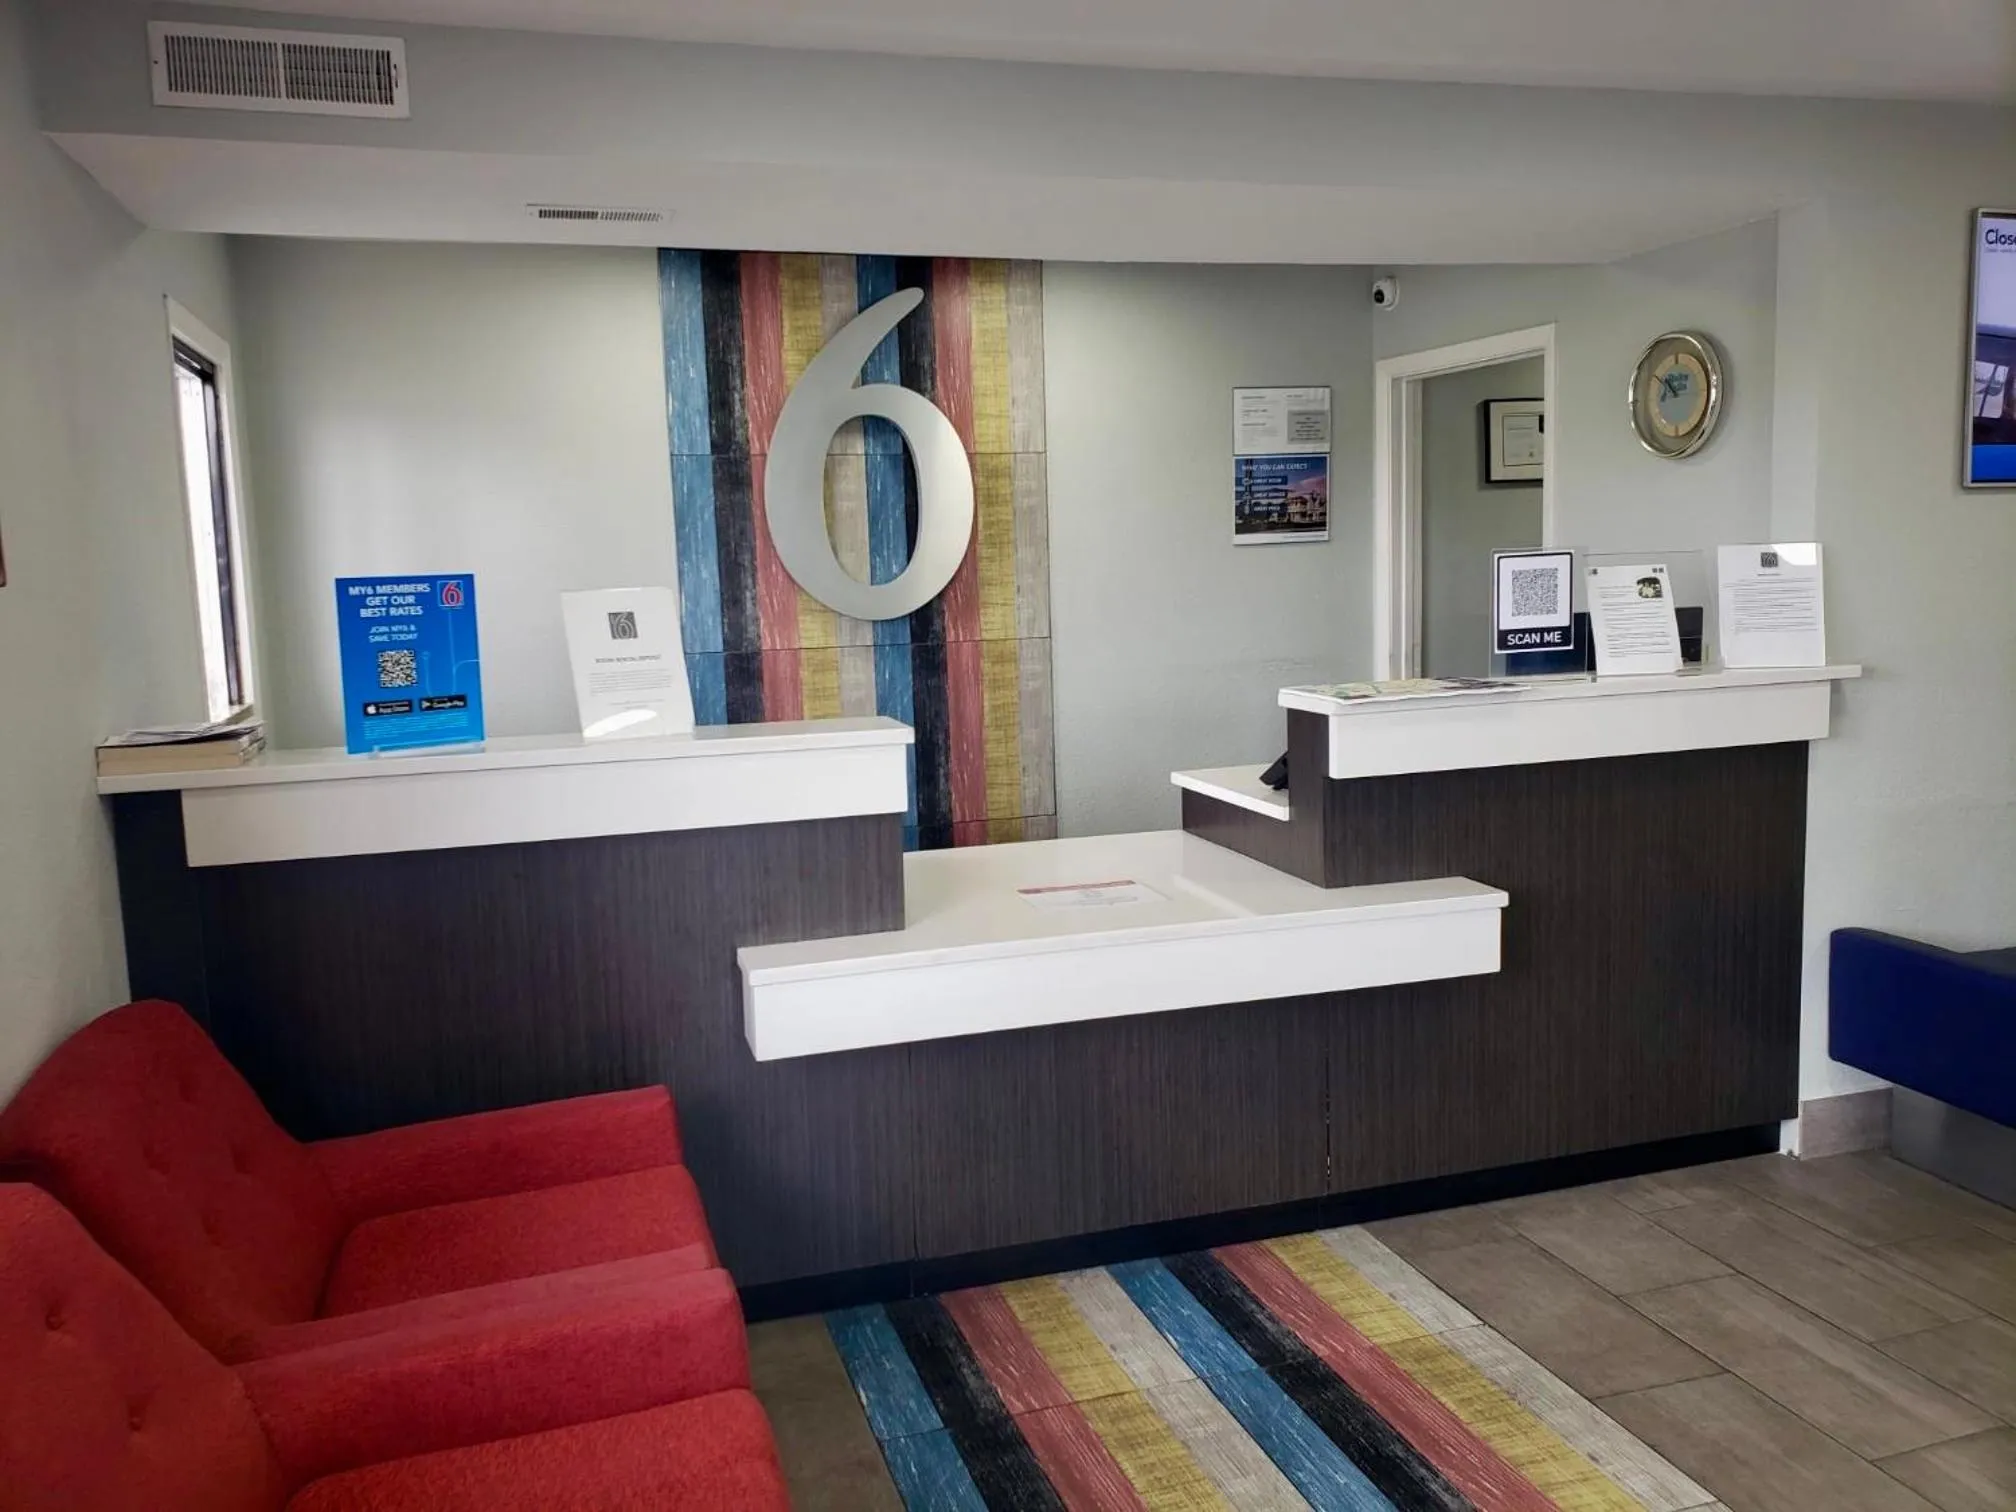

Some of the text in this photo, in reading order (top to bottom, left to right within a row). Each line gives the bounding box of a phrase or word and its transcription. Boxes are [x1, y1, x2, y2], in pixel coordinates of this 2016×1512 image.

[1985, 228, 2016, 245] Clos
[764, 287, 974, 621] 6
[348, 583, 431, 595] MY6 MEMBERS
[442, 582, 463, 606] 6
[366, 595, 416, 606] GET OUR
[360, 606, 424, 618] BEST RATES
[1507, 631, 1563, 645] SCAN ME
